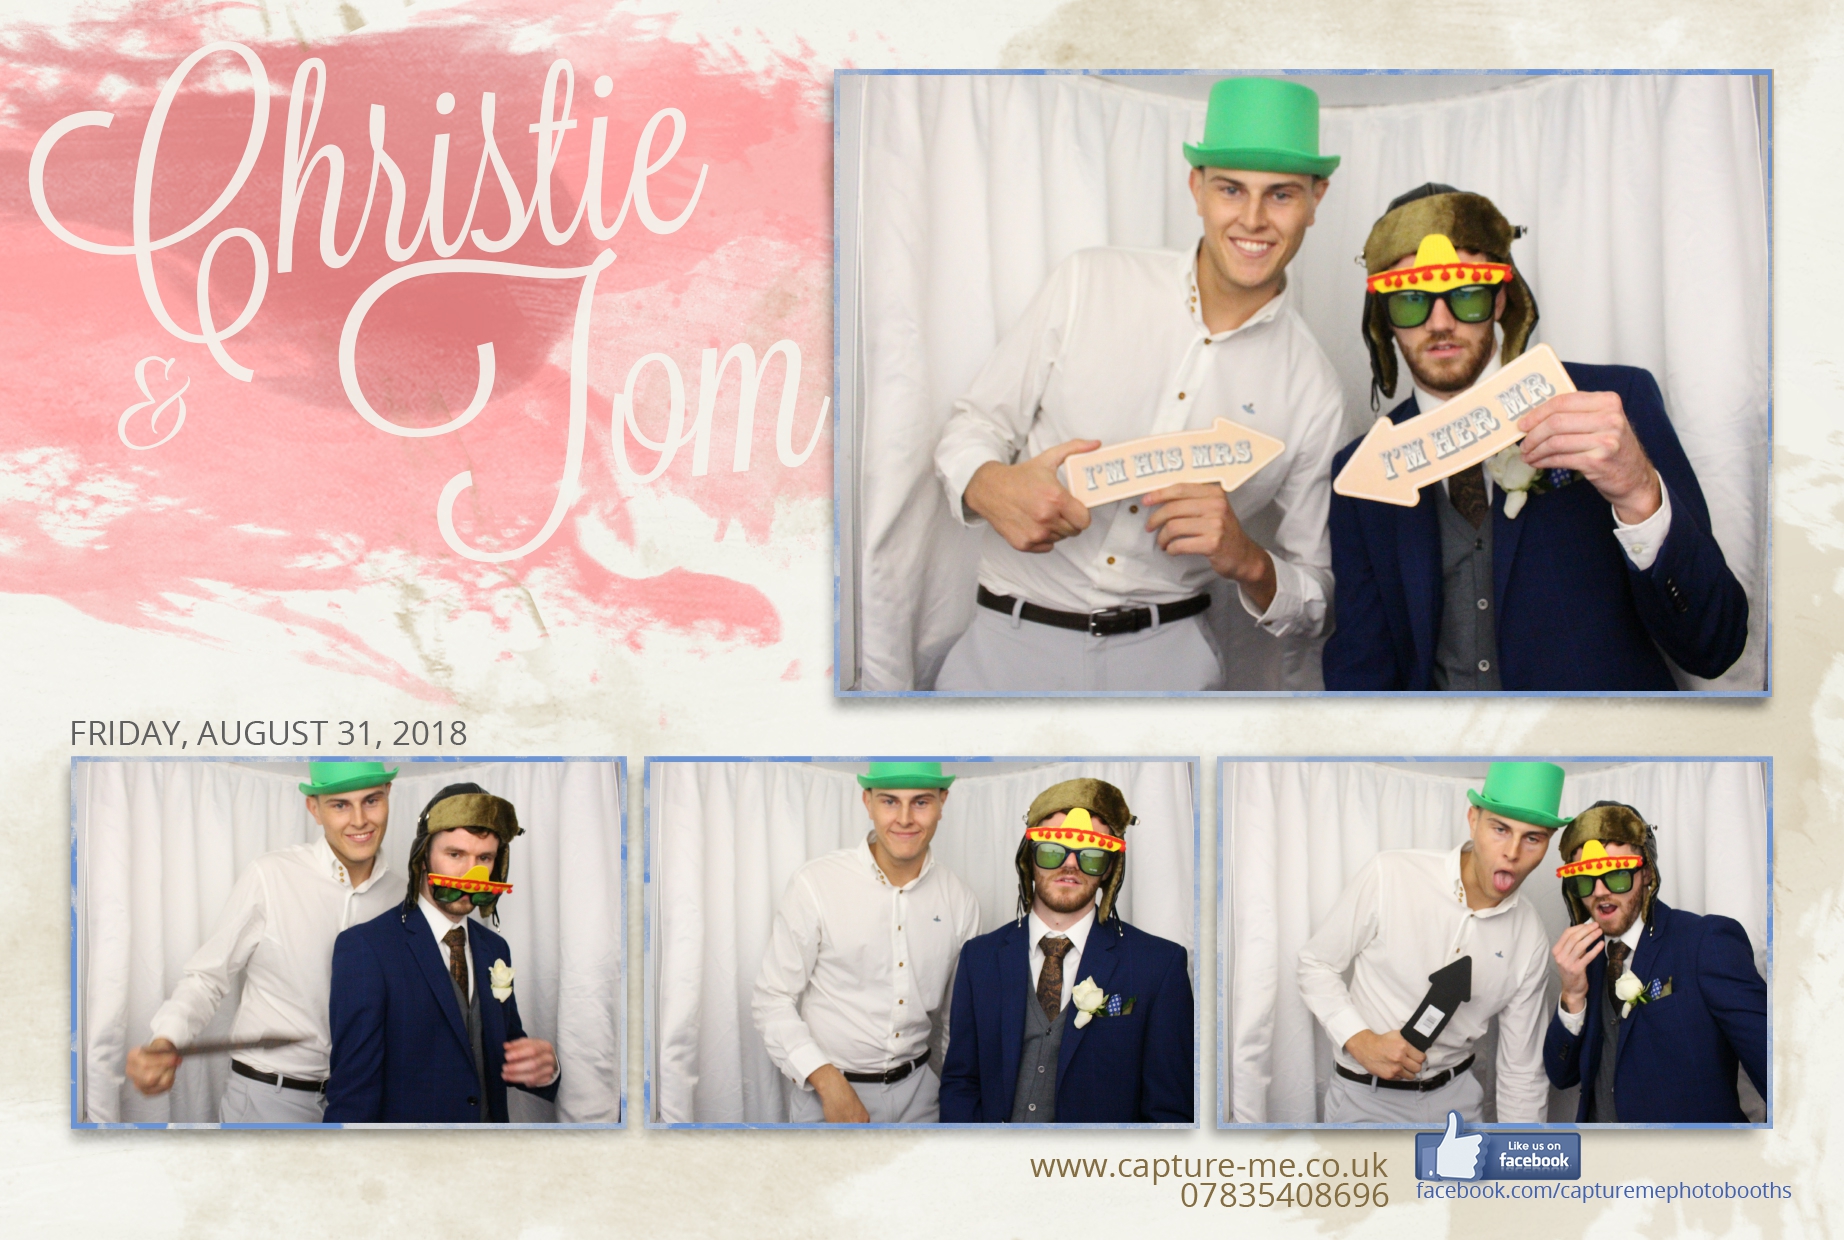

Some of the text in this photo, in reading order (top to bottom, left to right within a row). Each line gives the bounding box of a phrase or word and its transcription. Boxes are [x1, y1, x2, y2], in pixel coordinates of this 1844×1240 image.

[1083, 440, 1253, 491] I'M HIS MRS
[1380, 372, 1556, 481] I'M HER MR
